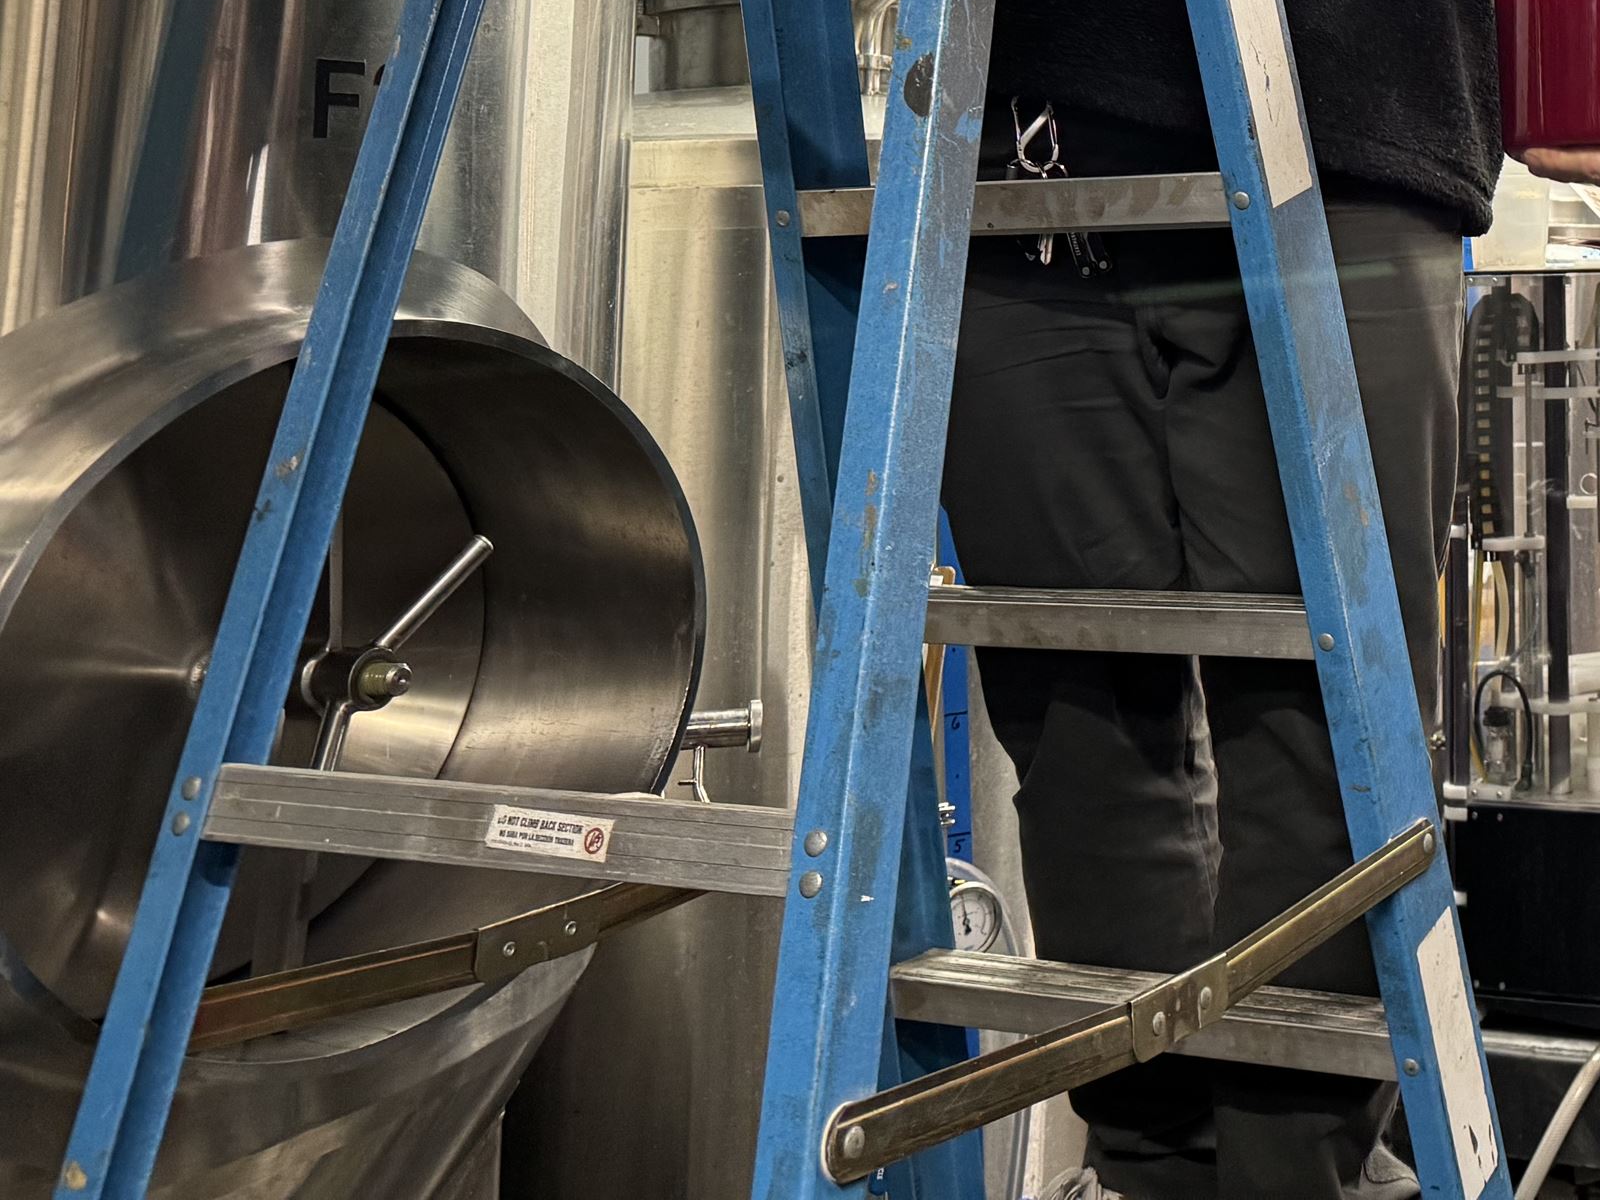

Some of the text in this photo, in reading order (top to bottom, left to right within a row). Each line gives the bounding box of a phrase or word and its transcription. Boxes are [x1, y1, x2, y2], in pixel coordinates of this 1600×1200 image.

[313, 59, 386, 138] F
[951, 716, 961, 730] 6
[541, 820, 557, 831] BACK
[557, 822, 583, 833] SECTION
[955, 838, 966, 853] 5
